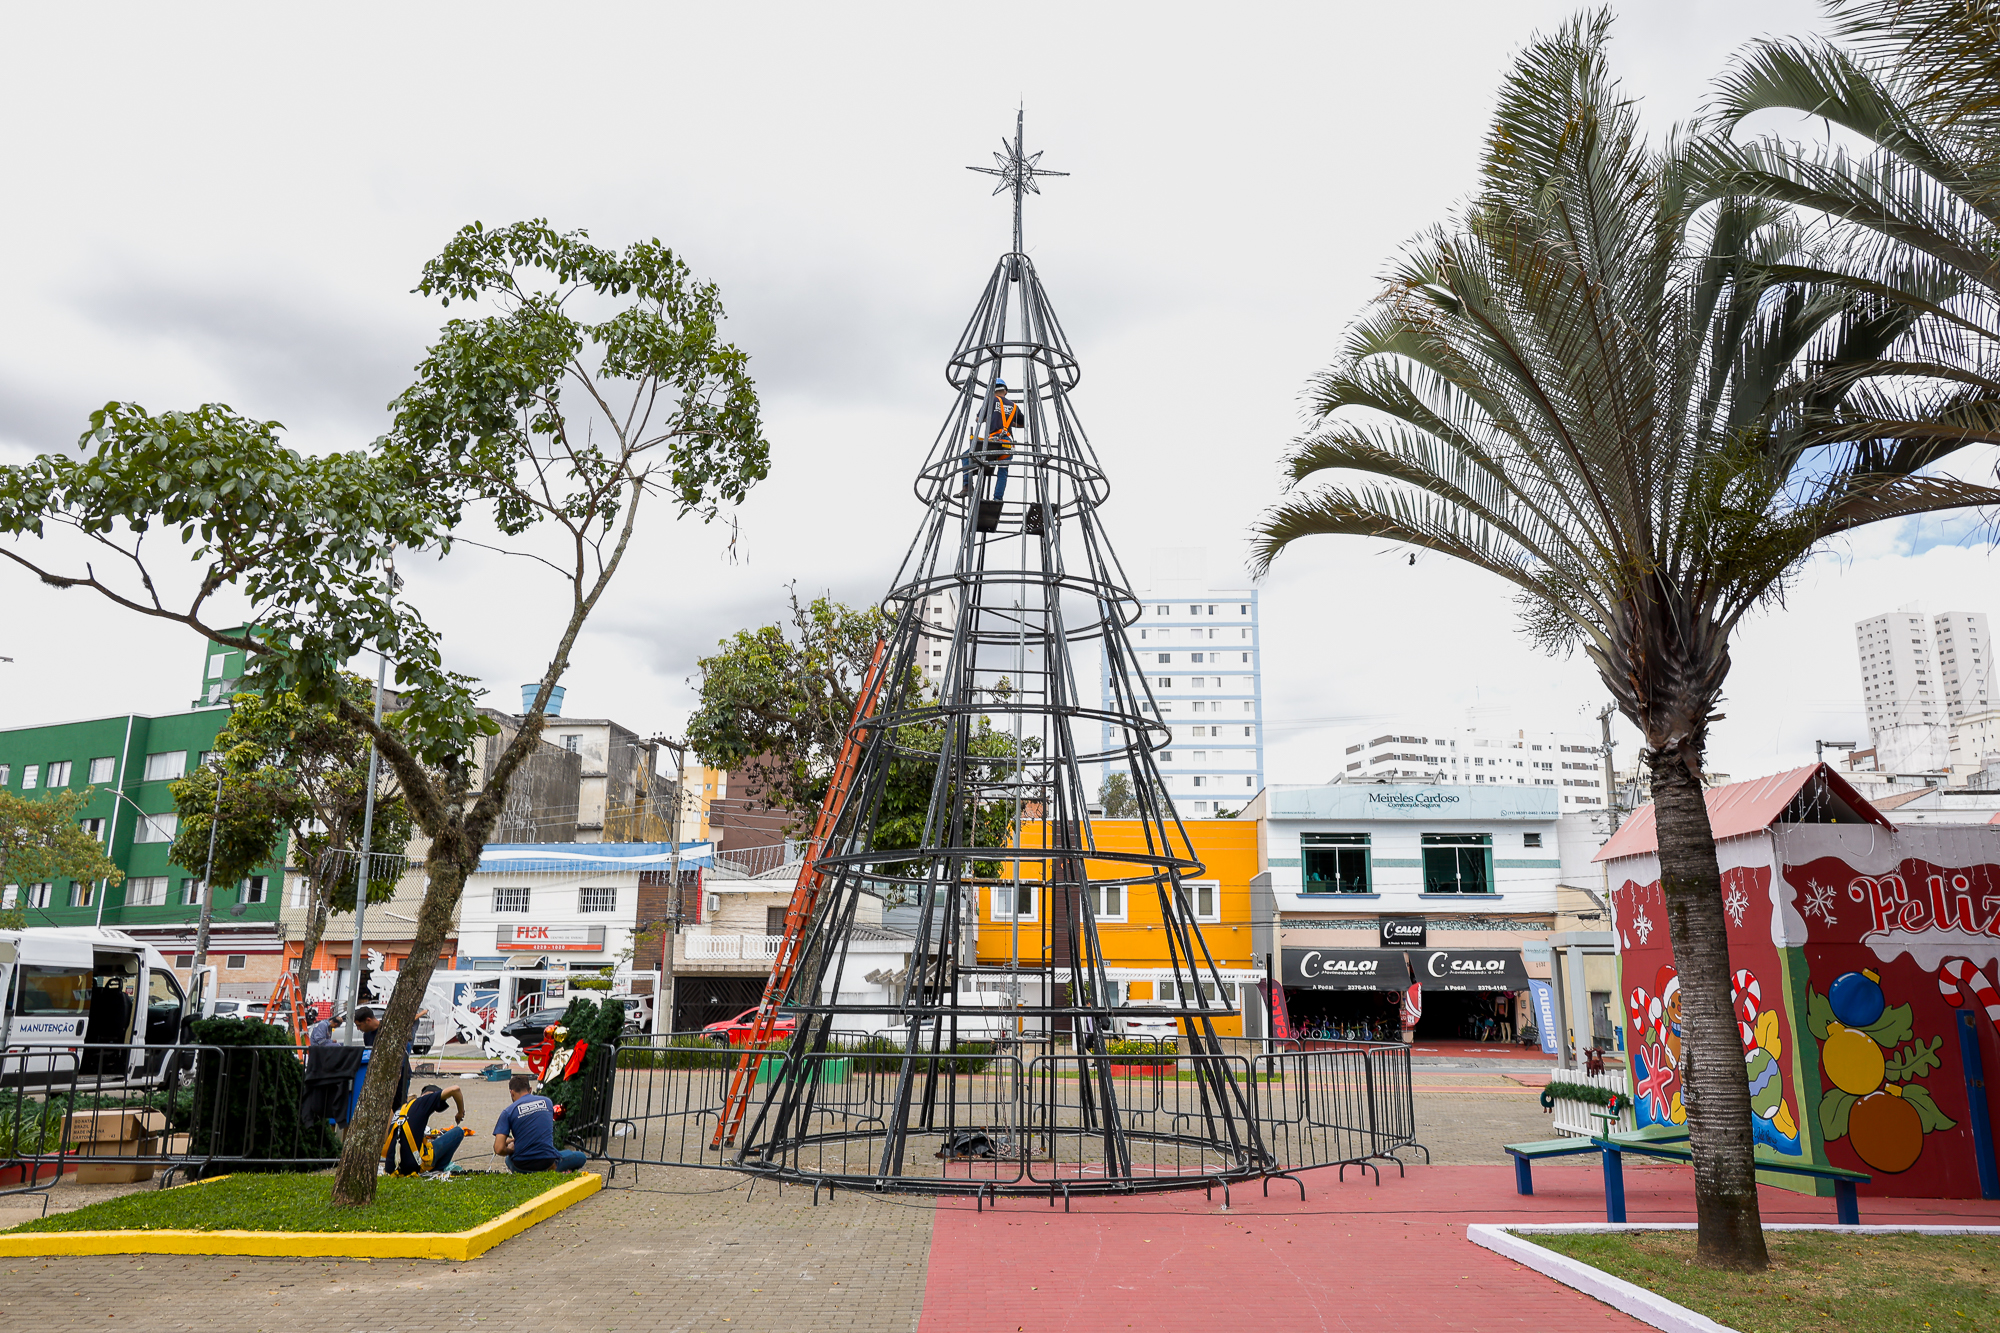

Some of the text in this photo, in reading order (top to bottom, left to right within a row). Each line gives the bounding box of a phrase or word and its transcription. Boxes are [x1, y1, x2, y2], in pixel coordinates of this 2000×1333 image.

[1369, 793, 1460, 803] Meireles Cardoso
[517, 926, 549, 939] FISK
[1395, 925, 1422, 934] CALOI
[1323, 960, 1379, 971] CALOI
[1451, 960, 1506, 971] CALOI
[1538, 988, 1557, 1049] SHIMANO
[19, 1022, 75, 1034] MANUTENÇÃO
